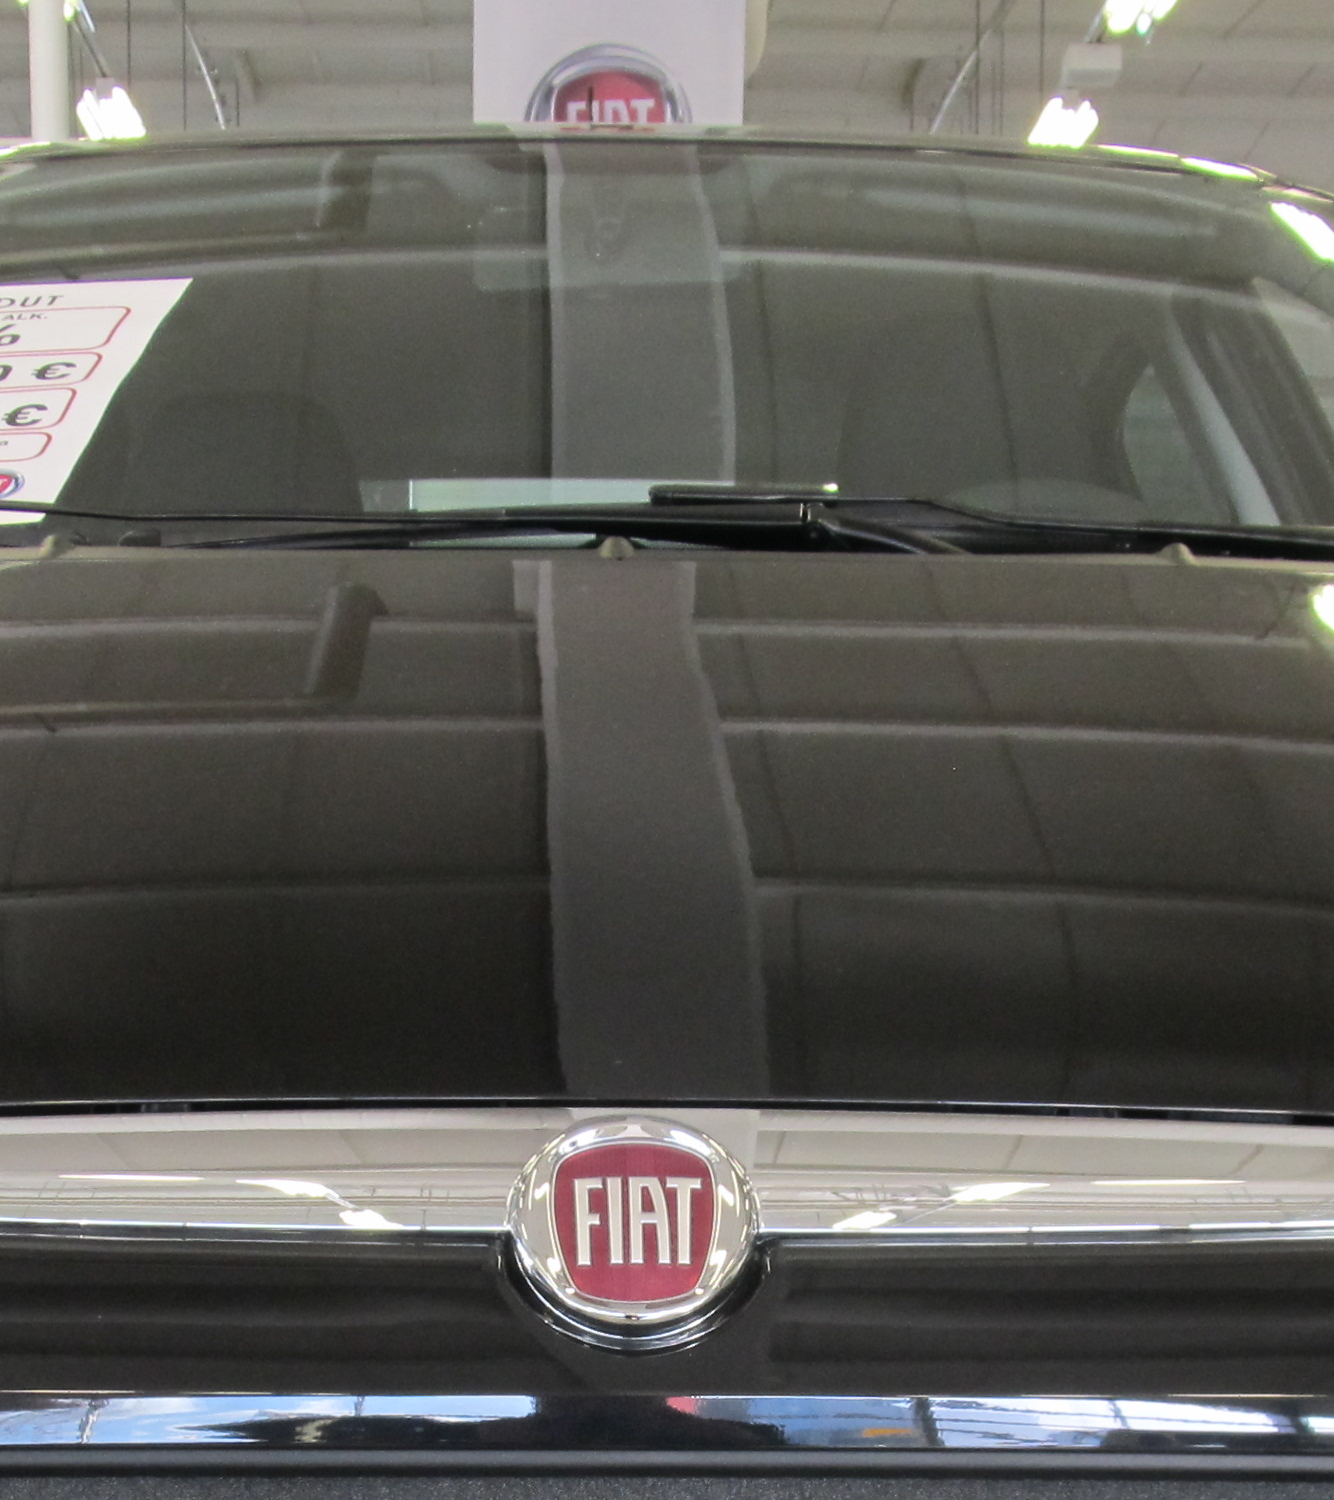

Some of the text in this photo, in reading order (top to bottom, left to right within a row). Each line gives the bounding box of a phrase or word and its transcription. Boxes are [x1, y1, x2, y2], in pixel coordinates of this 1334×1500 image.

[30, 361, 78, 381] €
[0, 403, 49, 427] €
[574, 1176, 703, 1266] FIAT
